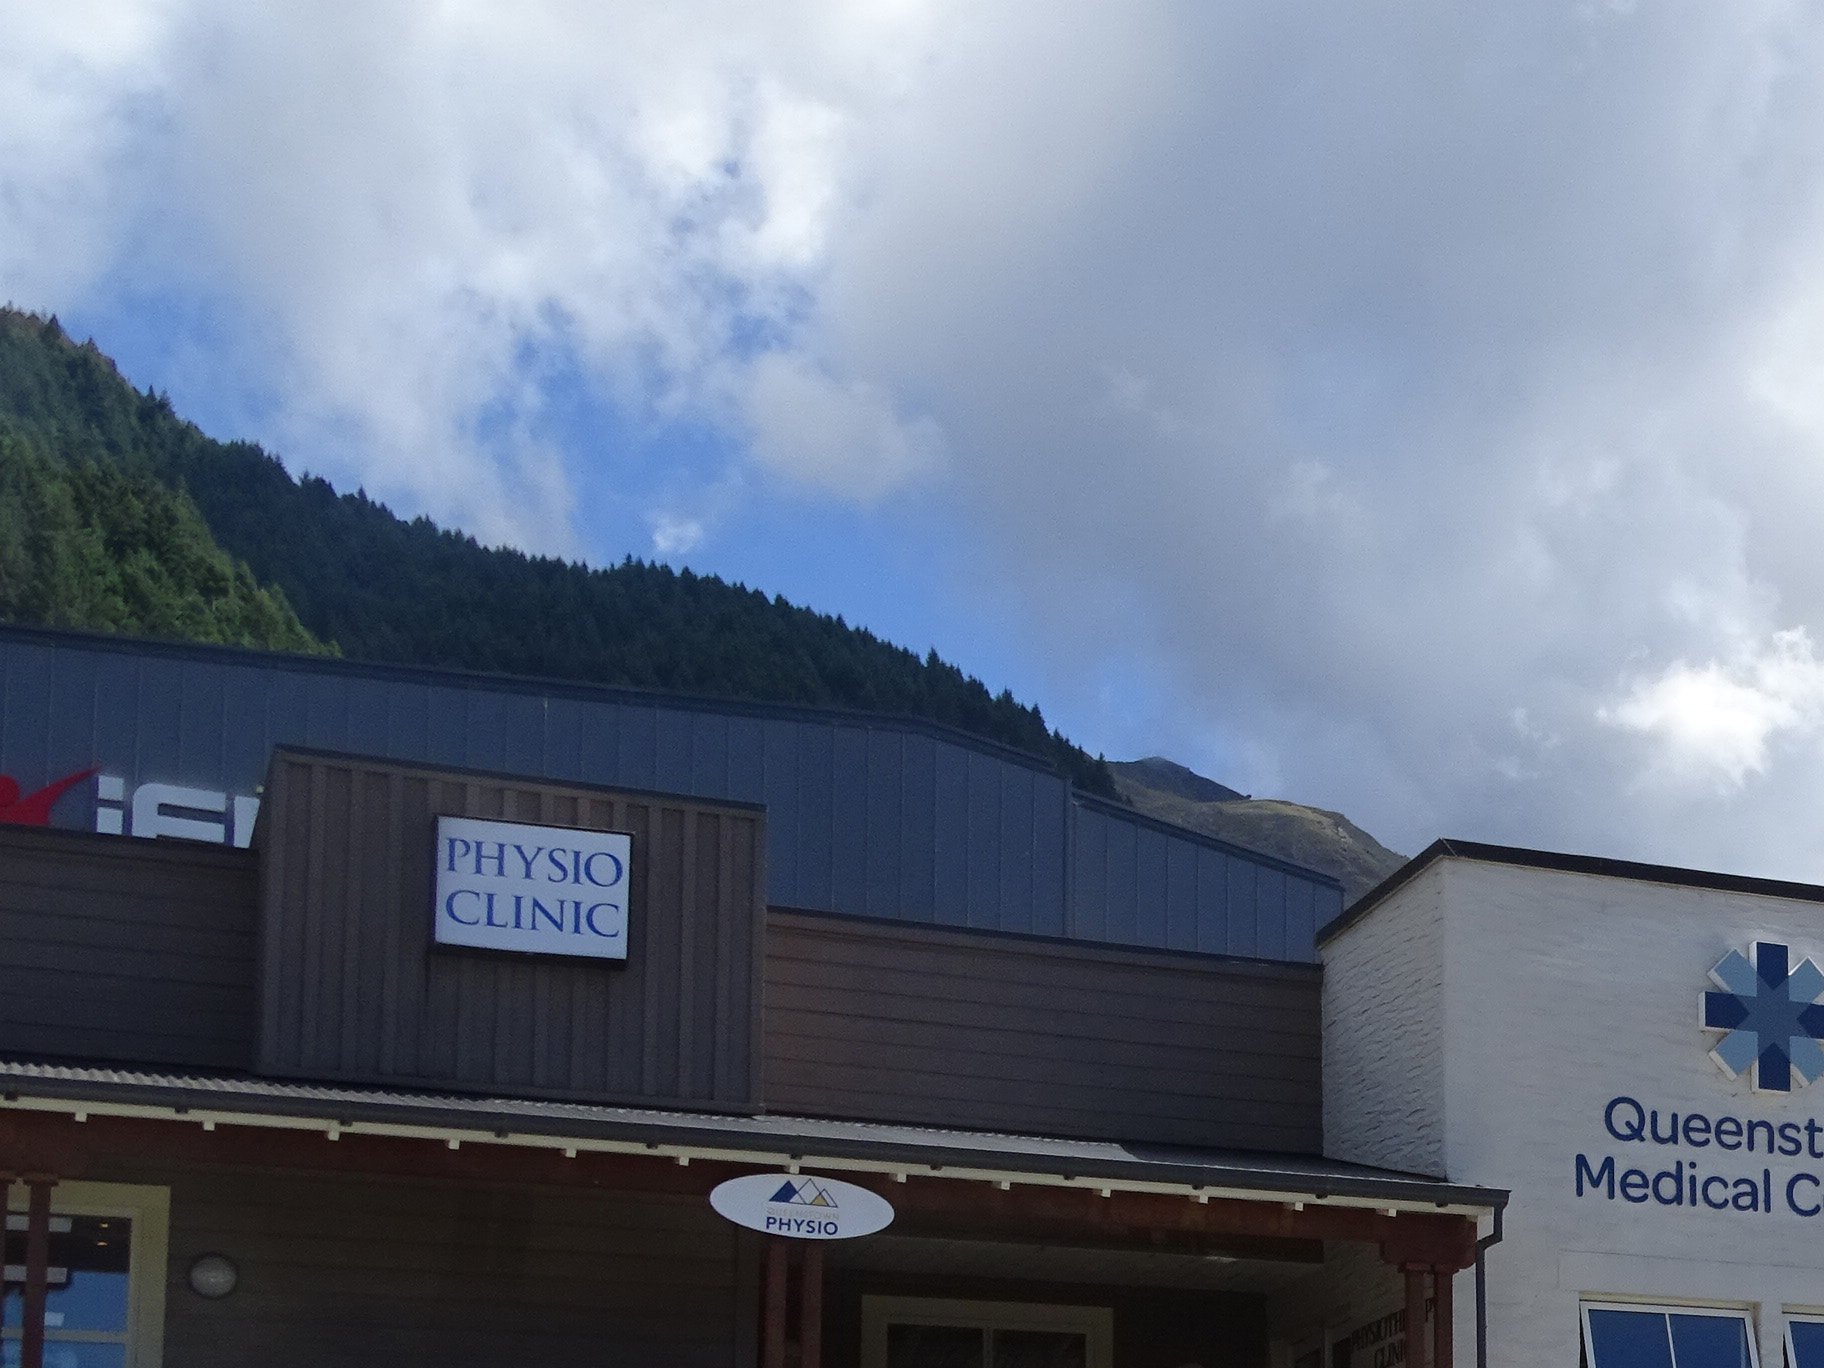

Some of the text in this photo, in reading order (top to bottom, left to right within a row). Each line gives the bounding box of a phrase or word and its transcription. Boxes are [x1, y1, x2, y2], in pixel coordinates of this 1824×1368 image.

[446, 837, 624, 887] PHYSIO
[445, 889, 620, 938] CLINIC
[1575, 1153, 1771, 1214] Medical
[766, 1217, 839, 1236] PHYSIO
